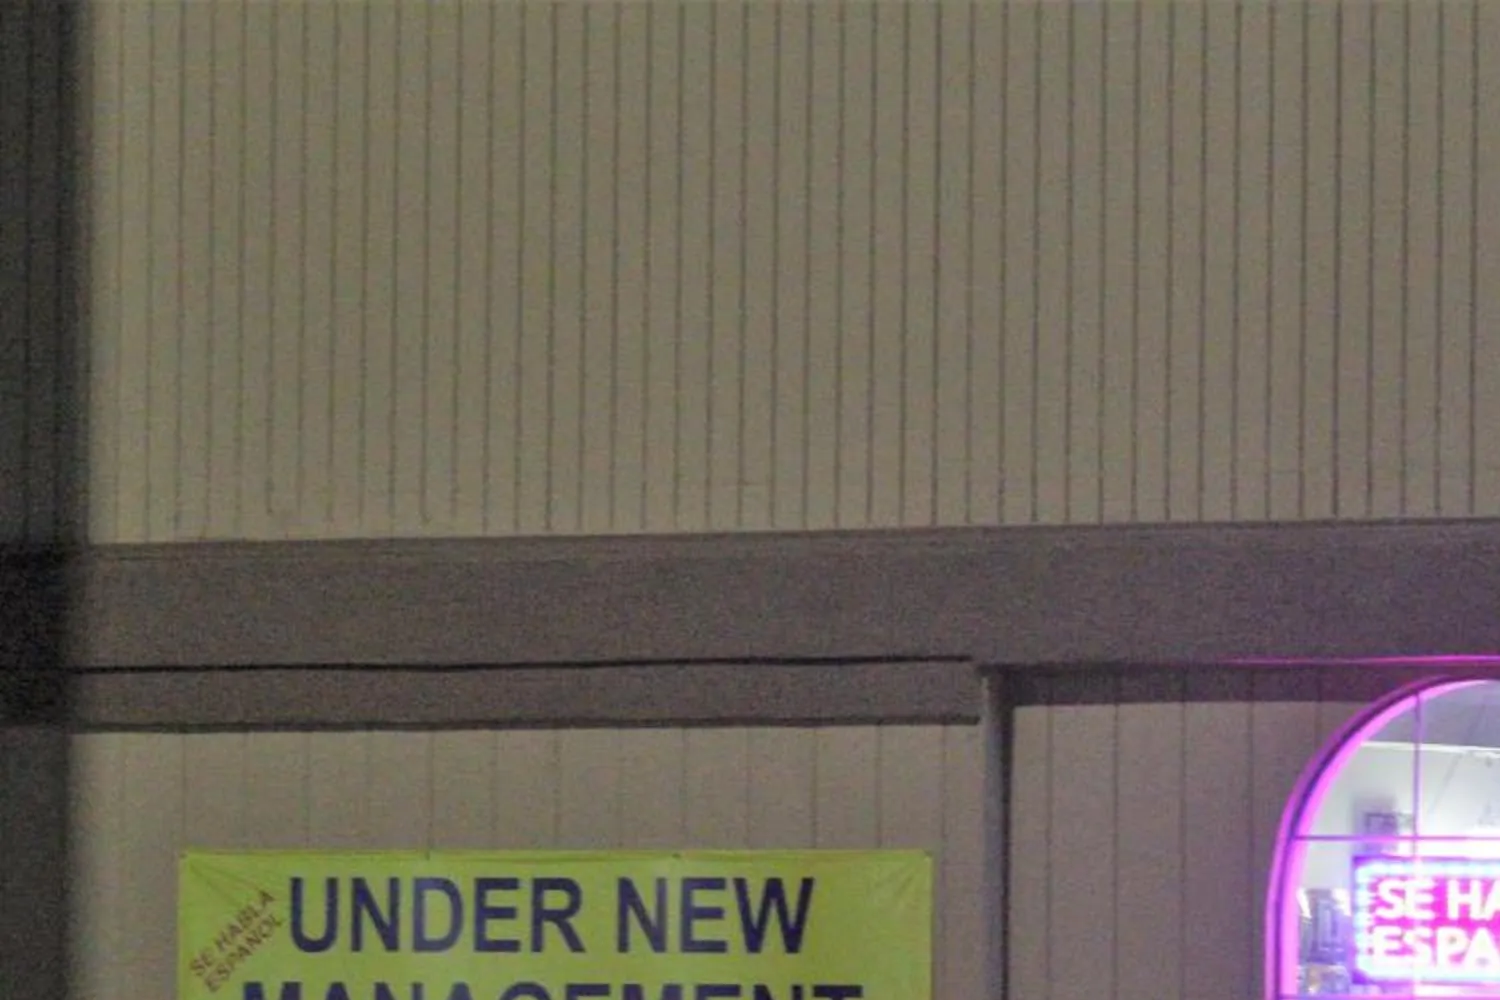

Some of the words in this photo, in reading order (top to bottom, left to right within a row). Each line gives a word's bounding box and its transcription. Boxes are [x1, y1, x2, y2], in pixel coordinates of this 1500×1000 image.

[189, 950, 216, 977] SE
[214, 889, 276, 952] HABLA
[289, 876, 582, 953] UNDER
[617, 876, 813, 953] NEW
[1374, 879, 1435, 921] SE
